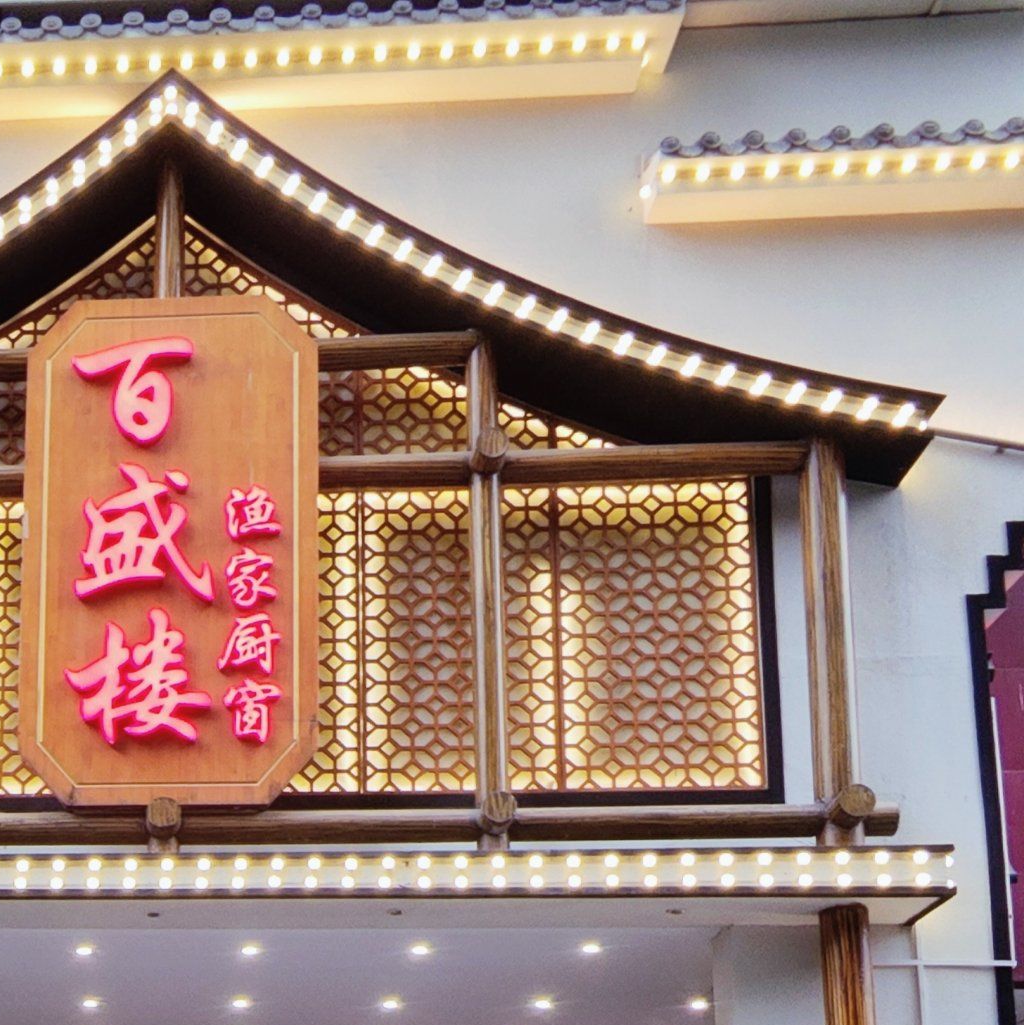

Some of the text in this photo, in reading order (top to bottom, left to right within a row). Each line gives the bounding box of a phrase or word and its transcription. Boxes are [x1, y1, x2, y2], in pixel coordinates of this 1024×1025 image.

[64, 336, 215, 746] 百盛楼
[216, 484, 282, 744] 渔家厨窗
